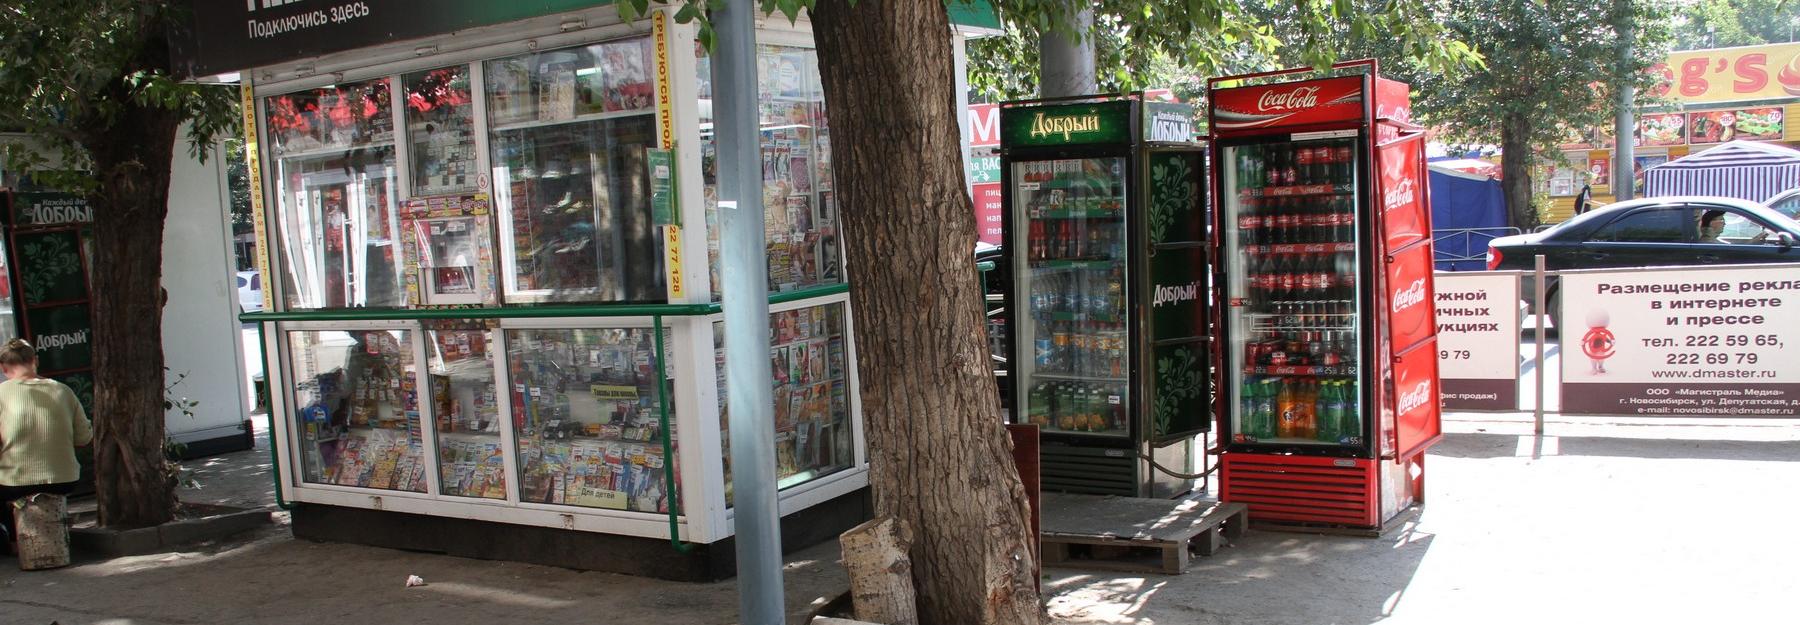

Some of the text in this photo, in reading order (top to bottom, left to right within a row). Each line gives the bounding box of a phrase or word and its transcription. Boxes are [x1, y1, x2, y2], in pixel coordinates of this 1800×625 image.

[247, 10, 328, 39] Подключись
[330, 1, 370, 23] здесь
[655, 13, 668, 105] ТРЕБУЮТСЯ
[1257, 85, 1321, 112] Coca-Cola
[1030, 107, 1101, 142] Добрый
[244, 86, 255, 138] РАБОТА
[250, 149, 264, 227] ПРОДАВЦАМ
[669, 225, 681, 293] 22 77 128
[1152, 281, 1198, 308] Добрый
[1435, 289, 1488, 301] жной
[1597, 281, 1731, 295] Размещение
[1651, 297, 1782, 311] в интернете
[1666, 314, 1765, 327] и прессе
[36, 329, 87, 351] Добрый
[1641, 334, 1784, 349] тел. 222 59 65,
[1454, 350, 1471, 360] 79
[1666, 352, 1758, 365] 222 69 79
[1651, 368, 1777, 378] www.dmaster.ru
[1459, 392, 1497, 401] продаж)
[1646, 388, 1784, 397] ООО «Магистраль Медиа»
[1629, 397, 1699, 406] Новосибирск,
[1701, 399, 1715, 407] ул.
[1719, 398, 1790, 407] Депутатская,
[1673, 407, 1795, 415] novosibirsk@dmaster.ru
[581, 487, 594, 497] Для
